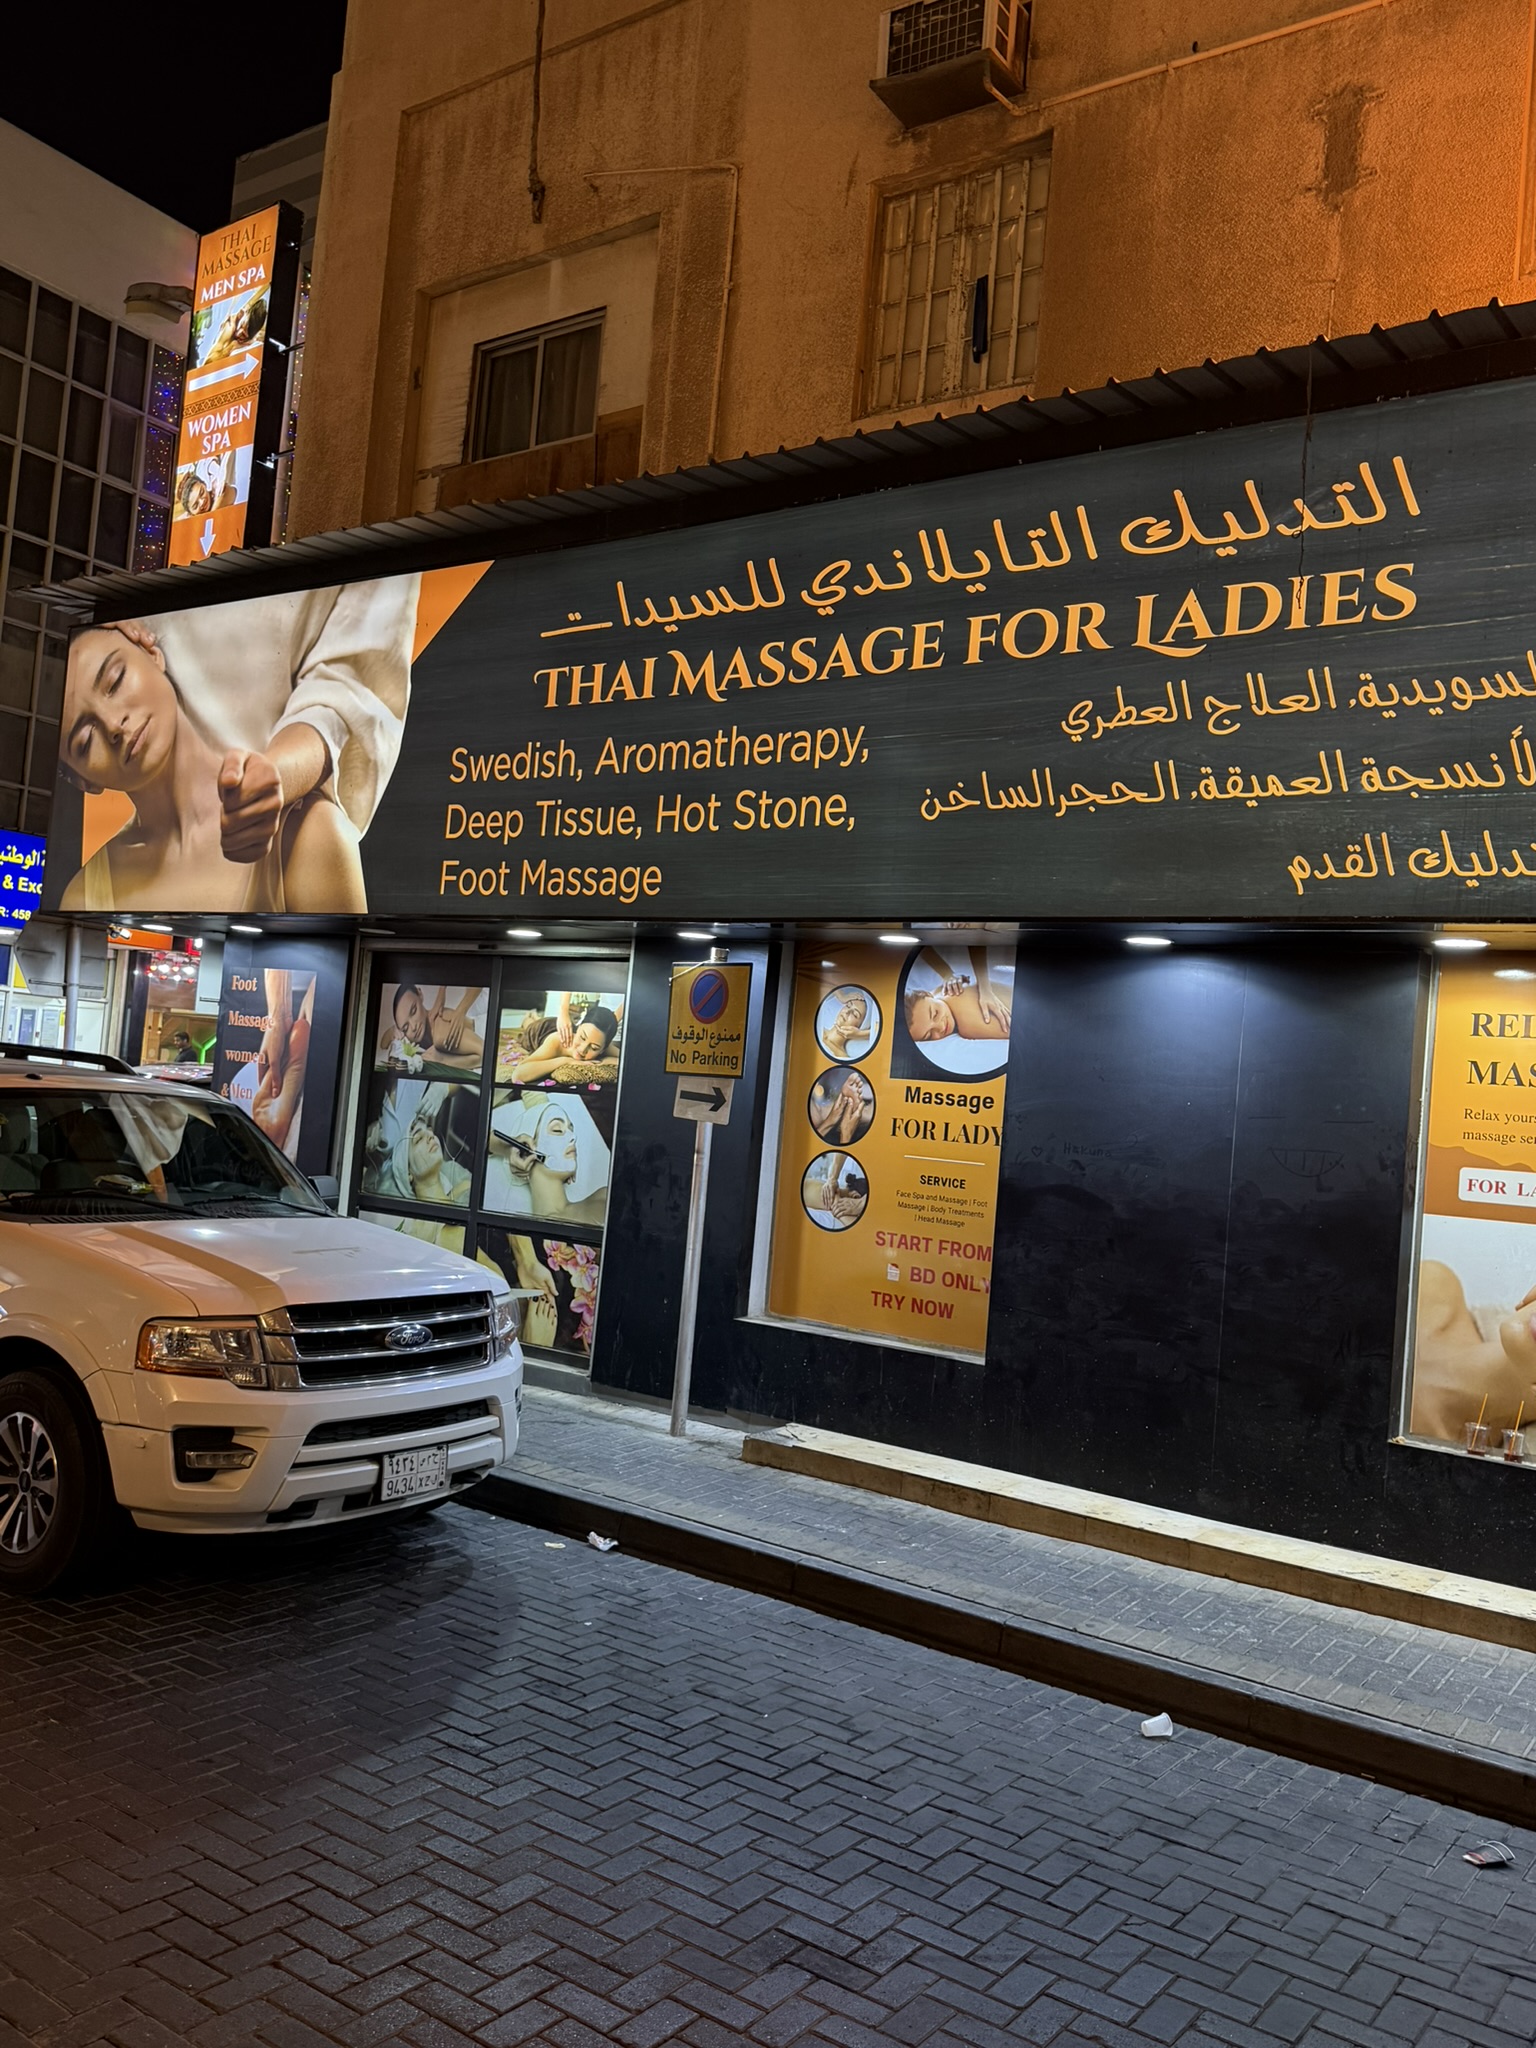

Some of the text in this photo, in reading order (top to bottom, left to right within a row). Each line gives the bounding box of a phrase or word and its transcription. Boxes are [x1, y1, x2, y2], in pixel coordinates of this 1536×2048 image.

[221, 223, 256, 252] THAI
[202, 235, 272, 279] MASSAGE
[200, 263, 266, 304] MEN SPA
[188, 401, 252, 438] WOMEN
[201, 430, 231, 455] SPA
[540, 455, 1421, 638] التدليك التايلاندي للسيدات
[534, 563, 1418, 708] THAI MASSAGE FOR LADIES
[1061, 679, 1193, 743] العطري
[1203, 666, 1337, 736] العلاج
[449, 725, 870, 783] Swedish, Aromatherapy,
[445, 789, 856, 846] Deep Tissue, Hot Stone,
[1287, 832, 1395, 896] القدم
[2, 874, 14, 890] &
[440, 859, 662, 904] Foot Massage
[231, 975, 258, 992] Foot
[228, 1010, 275, 1032] Massage
[671, 1026, 741, 1048] ممنوع الوقوف
[225, 1049, 266, 1065] women
[670, 1049, 739, 1070] No Parking
[220, 1083, 252, 1100] & Men
[904, 1085, 995, 1114] Massage
[1464, 1108, 1500, 1122] Relax
[890, 1117, 1003, 1147] FOR LADY
[1462, 1130, 1516, 1145] massage
[919, 1174, 966, 1190] SERVICE
[1467, 1178, 1507, 1195] FOR
[896, 1189, 988, 1208] Face Spa and Massage Foot
[897, 1201, 985, 1219] Massage Body Treatments
[918, 1214, 965, 1228] Head Massage
[875, 1231, 992, 1262] START FROM
[910, 1266, 936, 1285] BD
[941, 1271, 991, 1294] ONLY
[871, 1290, 954, 1319] TRY NOW
[400, 1329, 425, 1345] Ford
[387, 1476, 414, 1497] 9434
